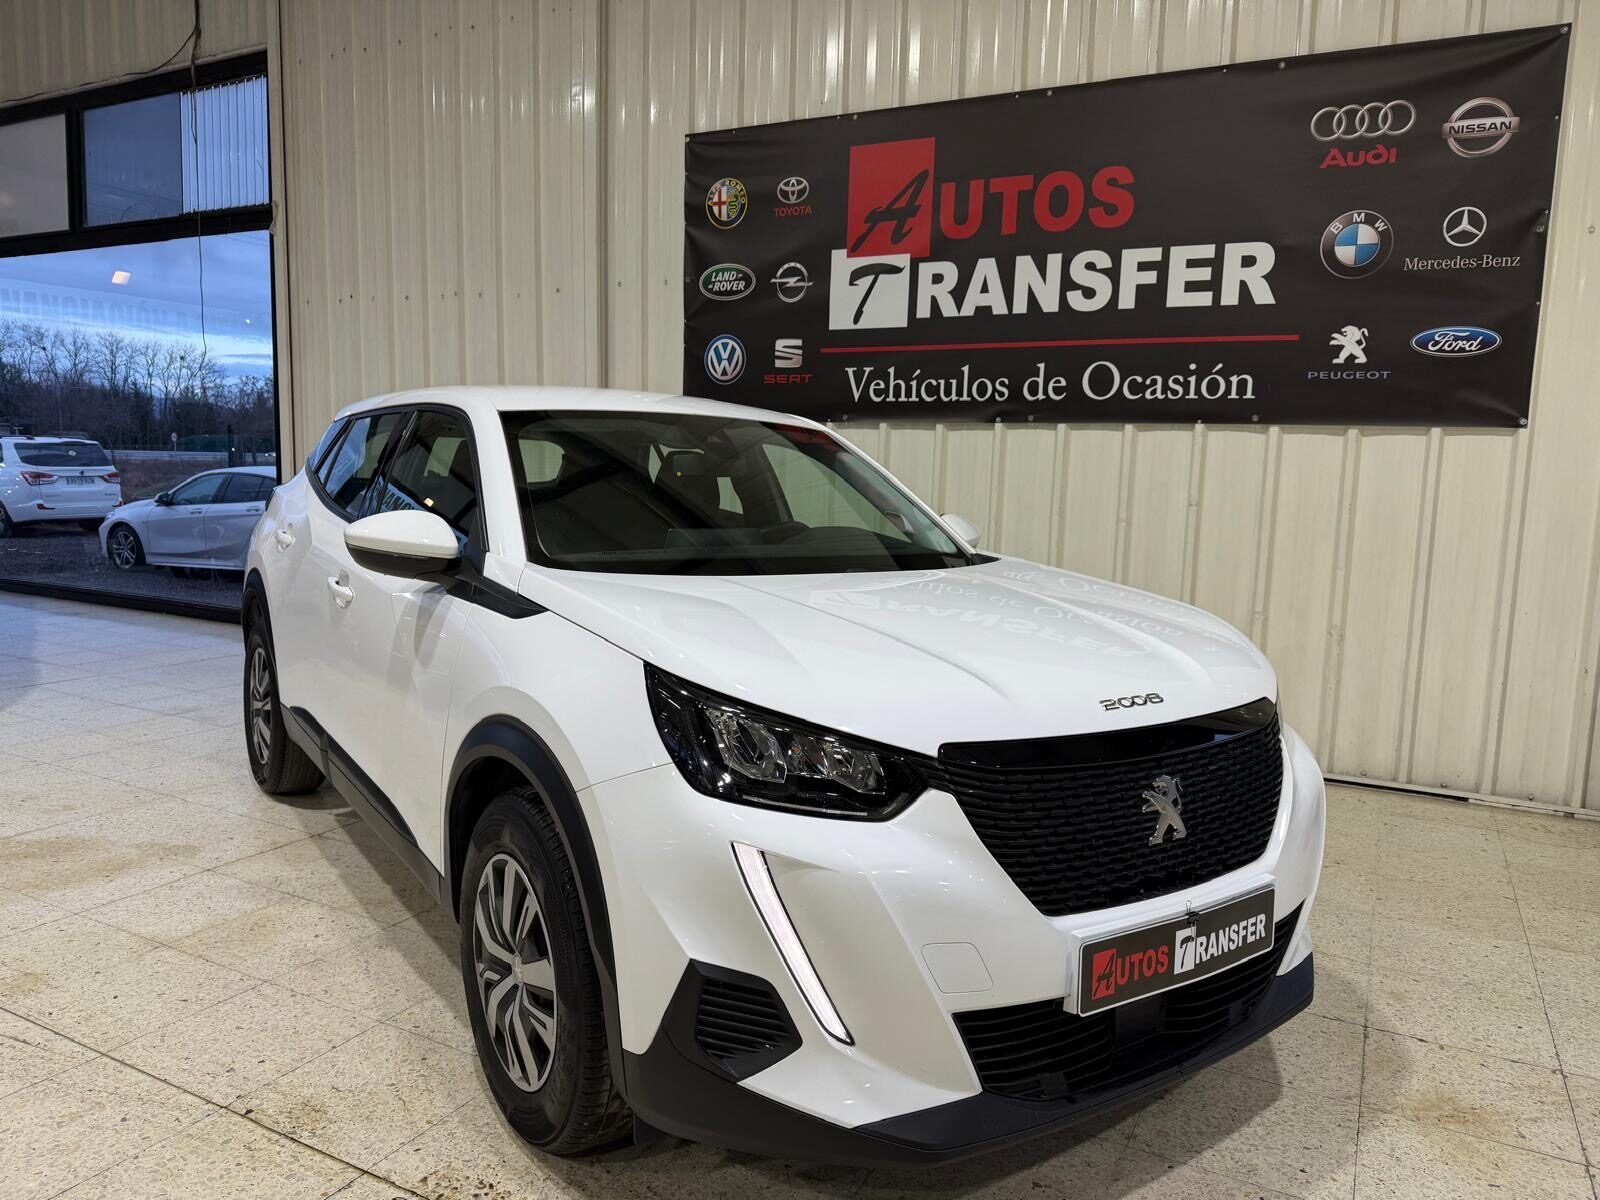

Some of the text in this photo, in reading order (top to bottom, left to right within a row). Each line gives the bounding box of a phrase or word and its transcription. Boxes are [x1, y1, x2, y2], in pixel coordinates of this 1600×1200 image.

[1448, 120, 1513, 135] NISSAN
[1320, 144, 1397, 168] Audi
[773, 205, 812, 217] TOYOTA
[850, 165, 1135, 253] AUTOS
[1330, 212, 1388, 234] BMW
[1404, 254, 1521, 271] Mercedes-Benz
[711, 271, 737, 282] LAND
[846, 241, 1276, 326] TRANSFER
[713, 281, 746, 292] ROVER
[1428, 331, 1481, 351] Ford
[763, 374, 812, 384] SEAT
[845, 361, 1256, 403] Vehículos de Ocasión
[1308, 370, 1391, 380] PEUGEOT
[1099, 692, 1164, 711] 2008
[1092, 913, 1266, 998] AUTOS TRANSFER
